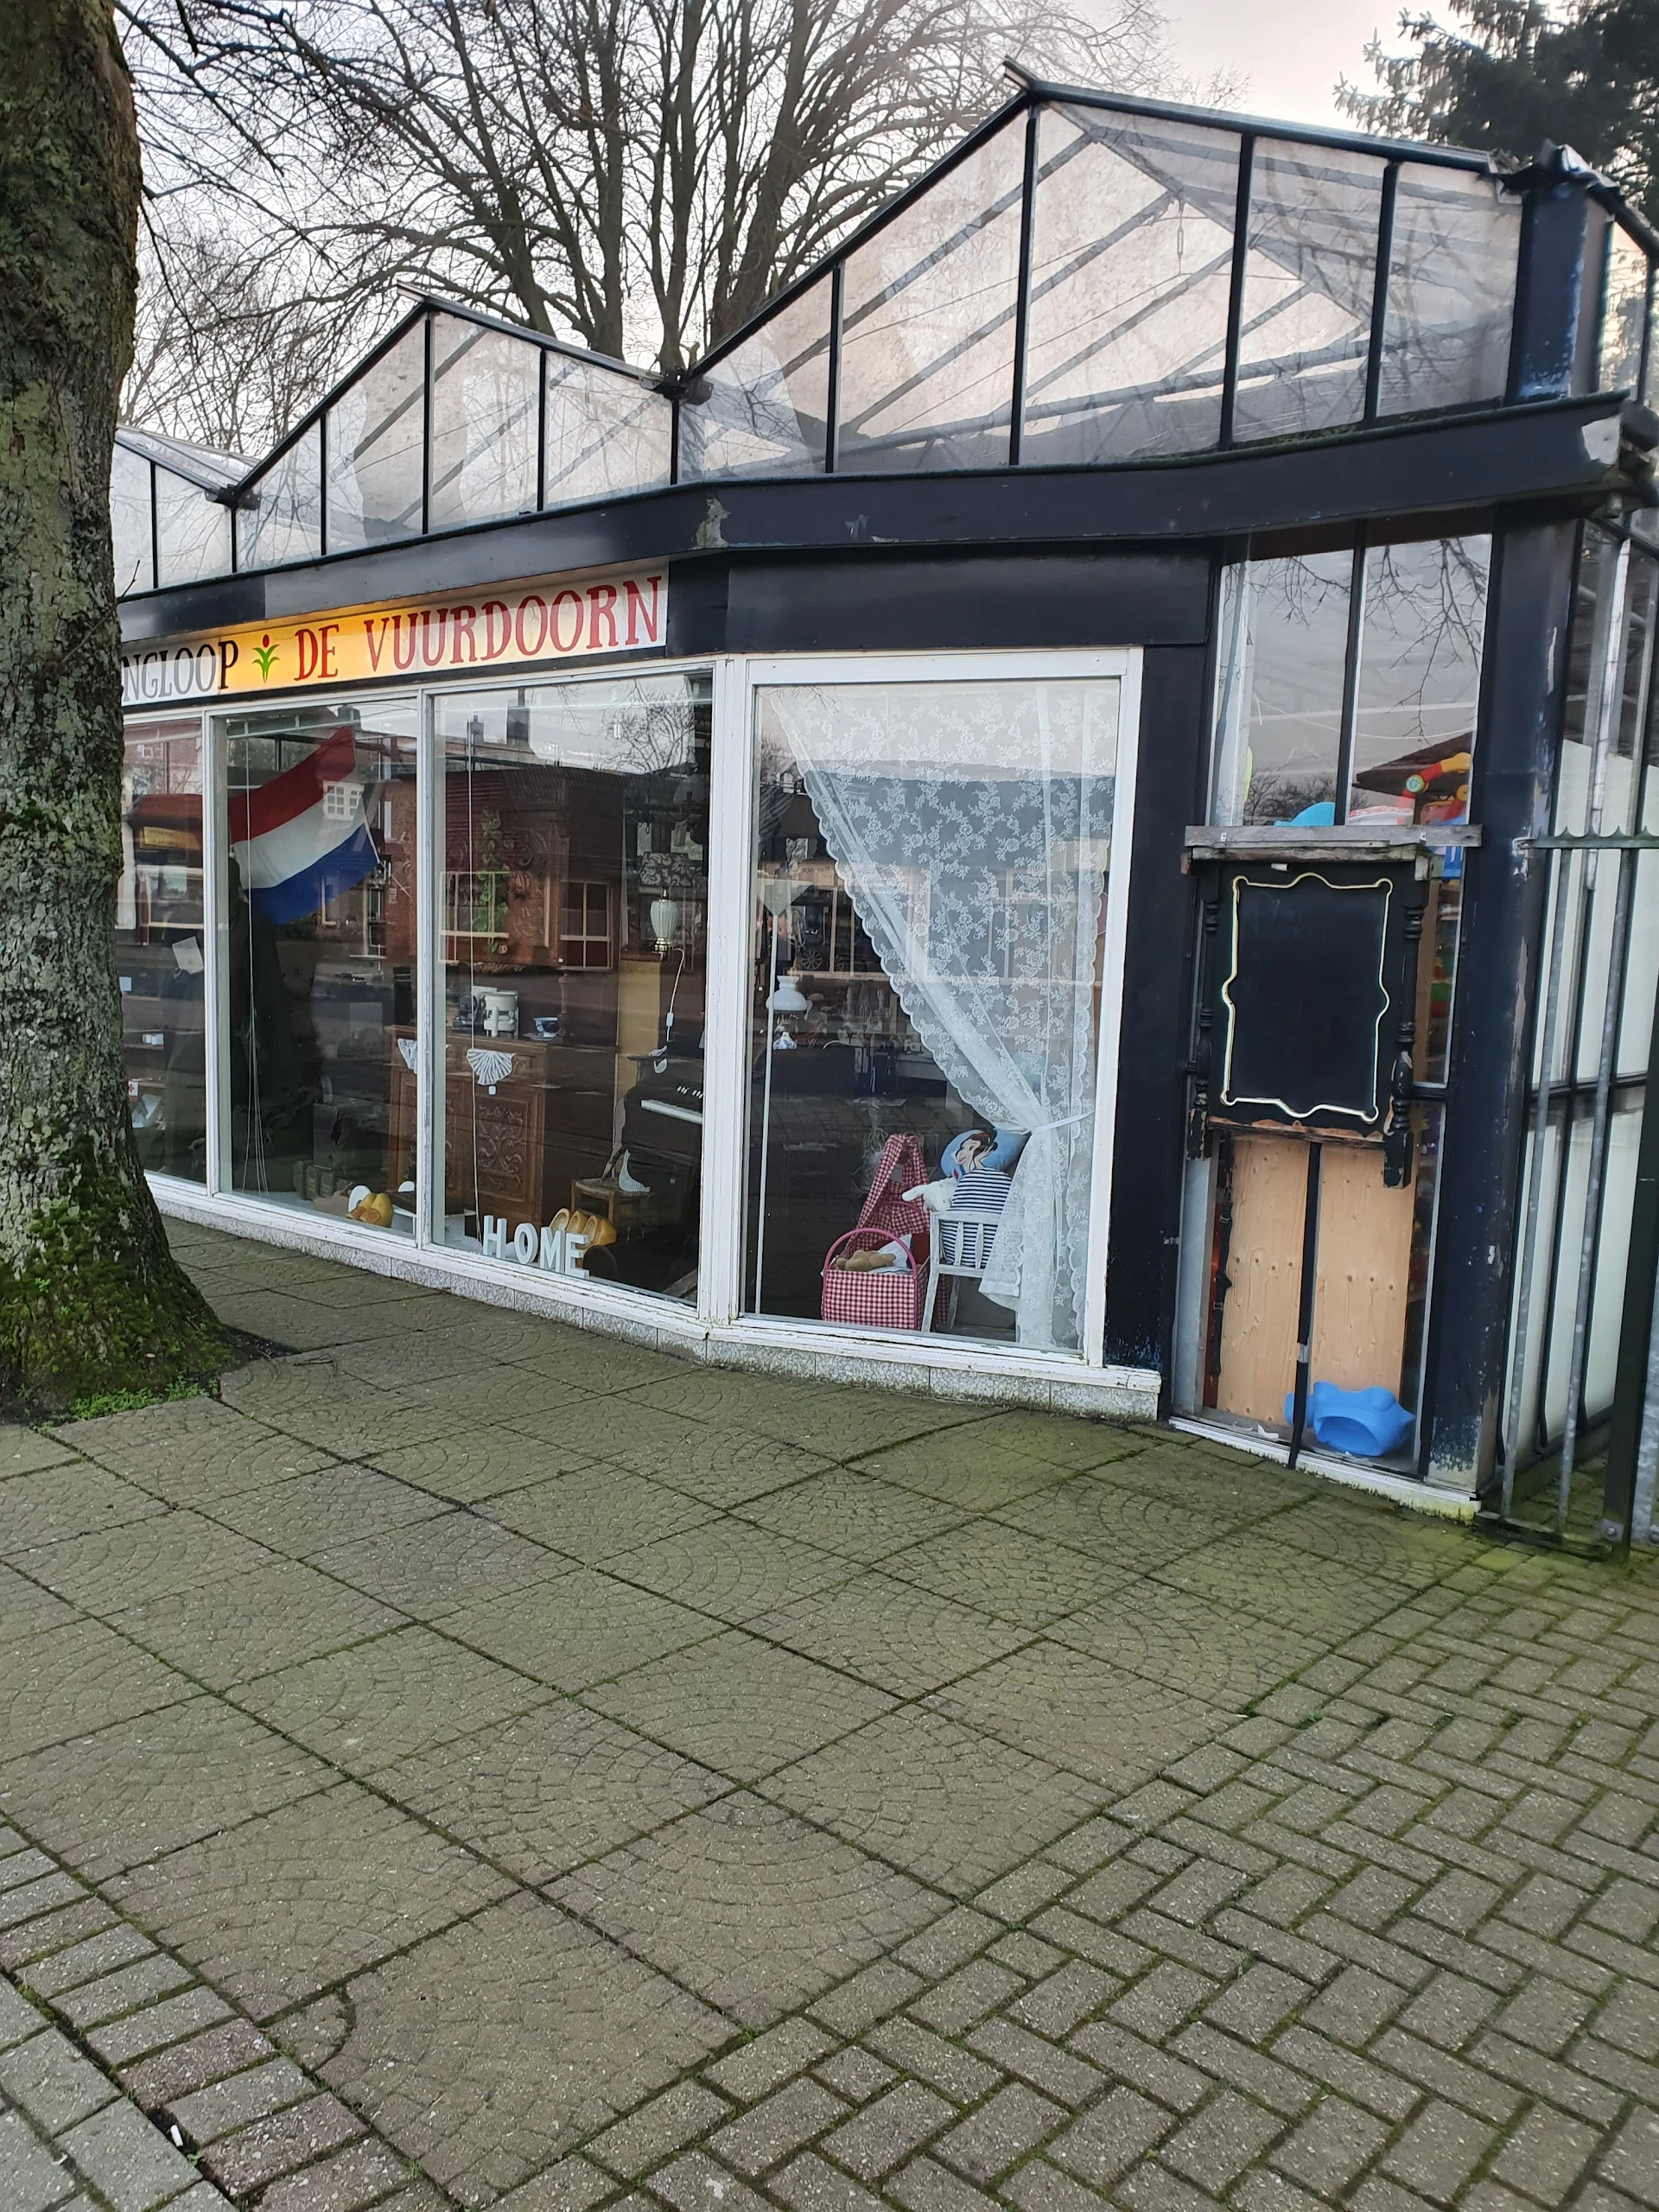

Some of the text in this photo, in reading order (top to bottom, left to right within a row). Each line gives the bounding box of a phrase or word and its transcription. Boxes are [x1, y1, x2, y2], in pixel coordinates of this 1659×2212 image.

[122, 575, 663, 702] NGLOOP DE VUURDOORN
[483, 1215, 589, 1279] HOME
